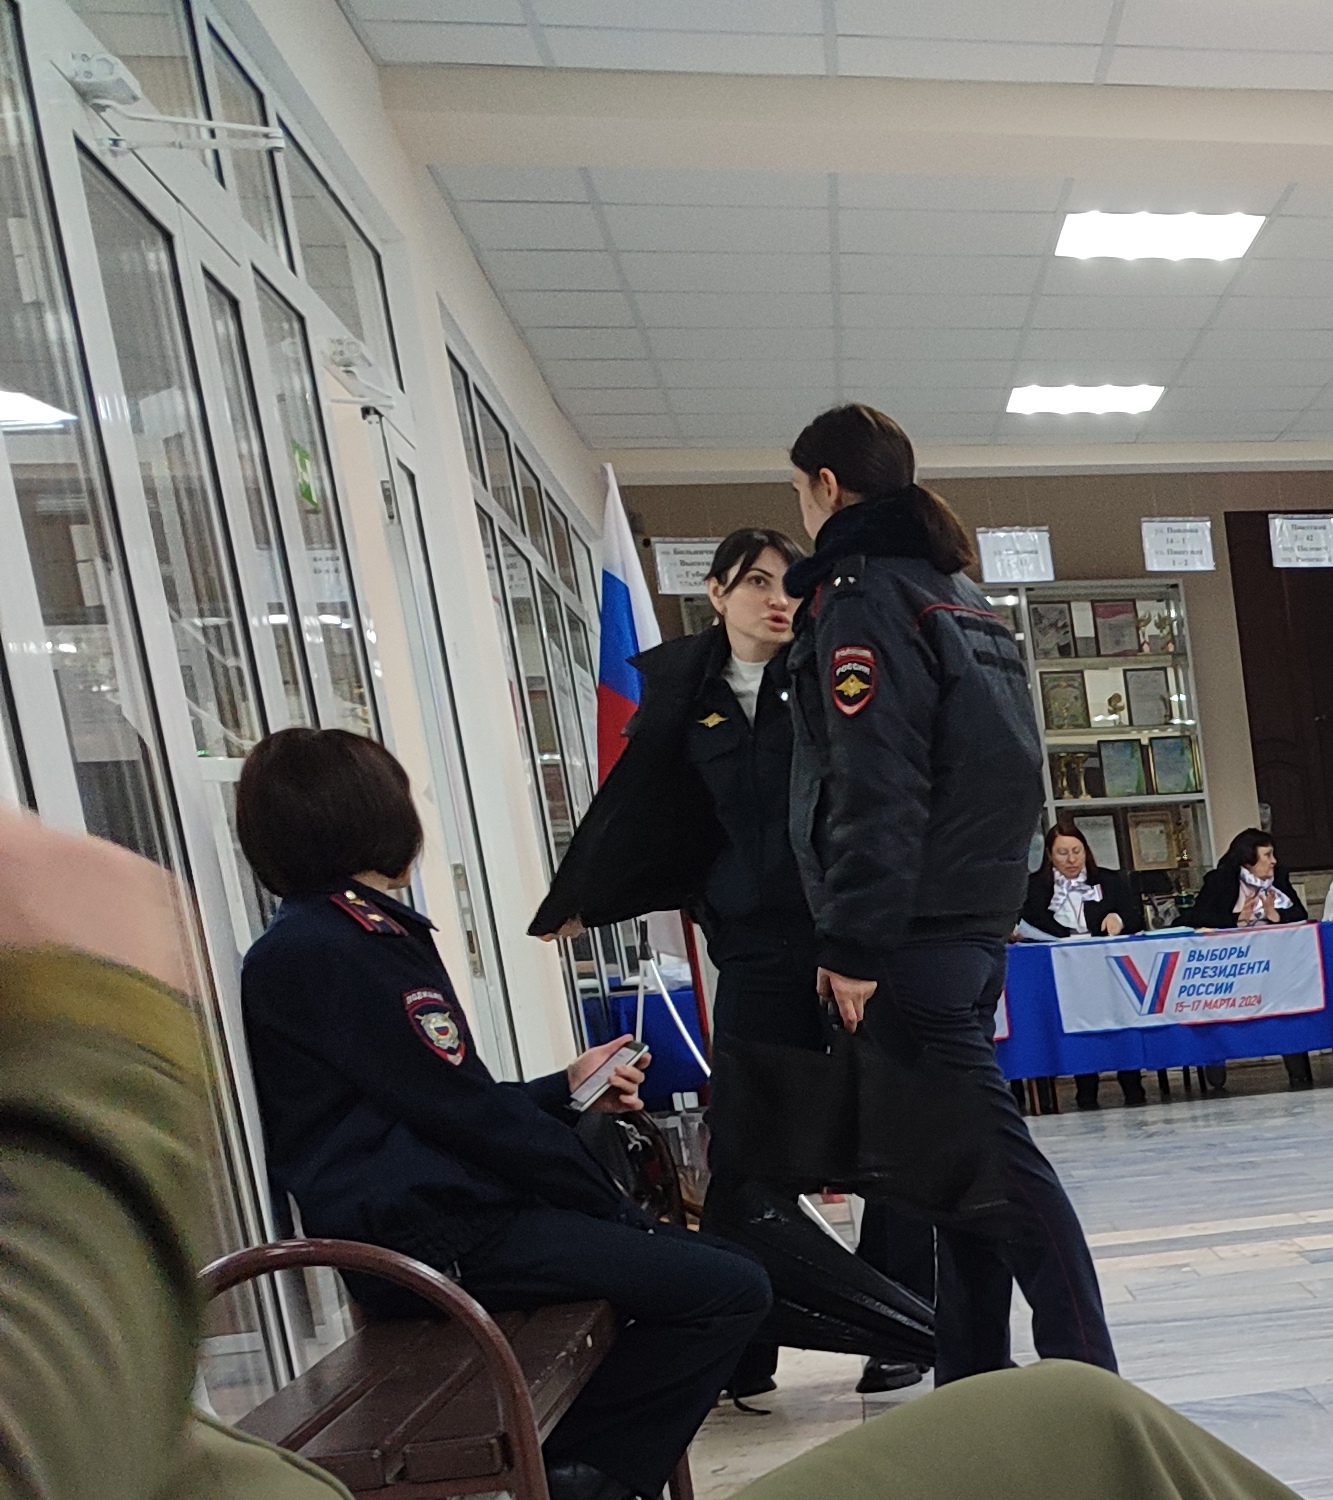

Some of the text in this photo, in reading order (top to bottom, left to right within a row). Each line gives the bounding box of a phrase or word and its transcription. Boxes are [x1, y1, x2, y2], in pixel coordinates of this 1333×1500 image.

[1187, 945, 1250, 963] ВЫБОРЫ
[1182, 959, 1271, 980] ПРЕЗИДЕНТА
[1177, 981, 1236, 998] РОССИИ
[1202, 997, 1237, 1011] МАРТА
[1238, 994, 1262, 1008] 2024
